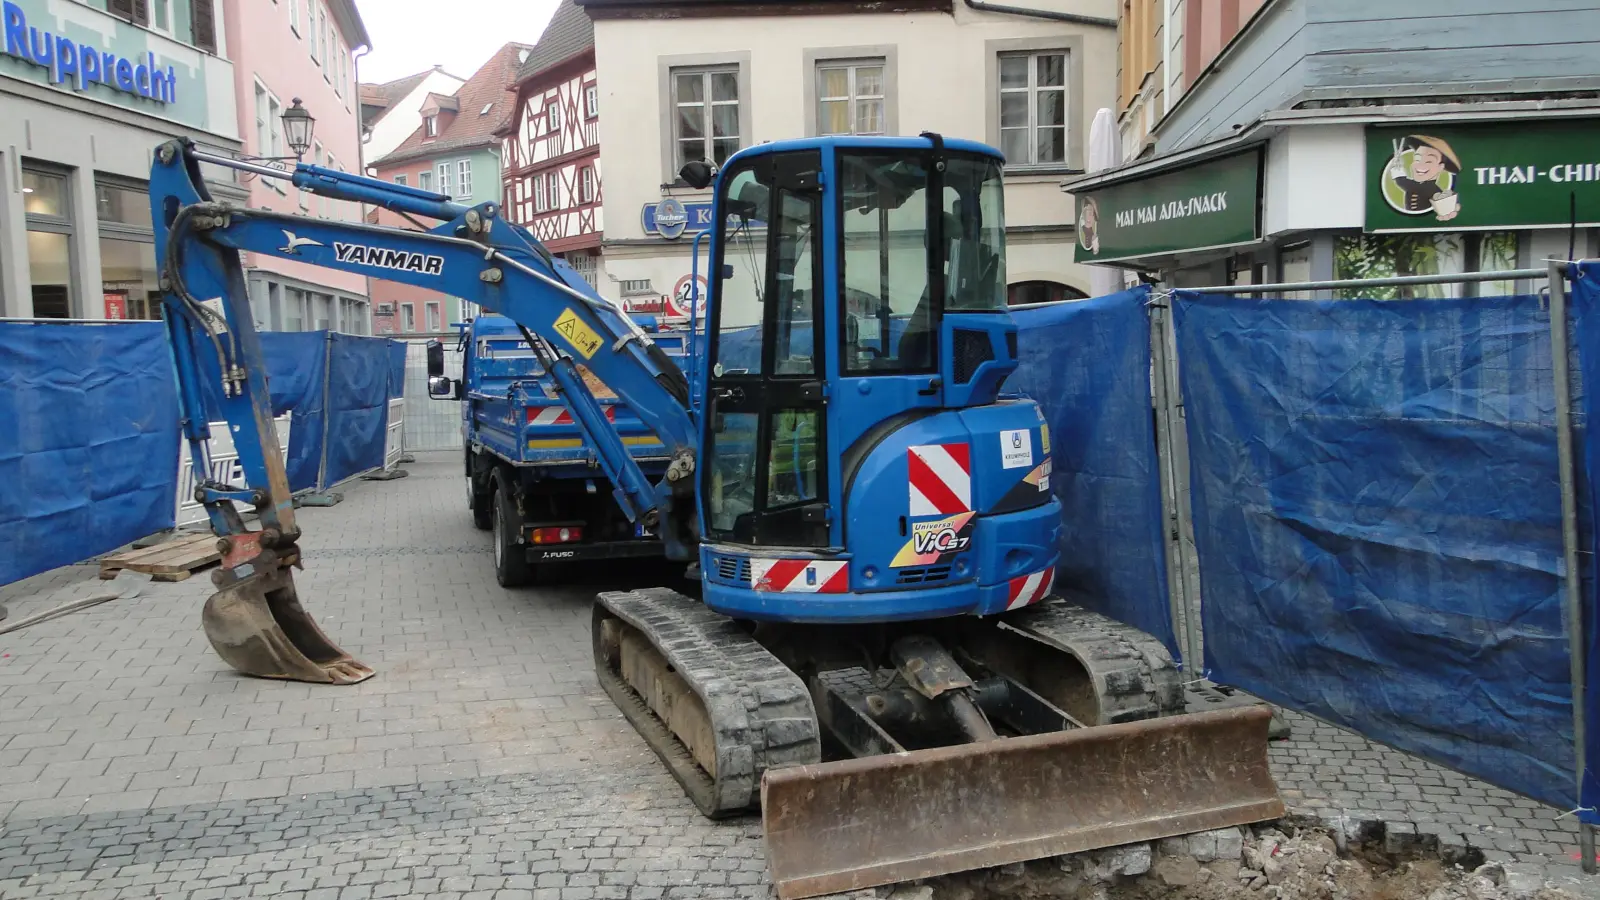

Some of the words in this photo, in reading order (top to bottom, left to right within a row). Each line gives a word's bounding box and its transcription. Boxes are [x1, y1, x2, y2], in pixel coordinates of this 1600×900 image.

[3, 0, 176, 104] Rupprecht
[656, 213, 684, 221] Tucher
[1115, 209, 1134, 228] MAI
[1137, 205, 1157, 225] MAI
[1159, 191, 1227, 220] ASIA-SNACK
[334, 241, 444, 275] YANMAR
[915, 520, 955, 531] Universal
